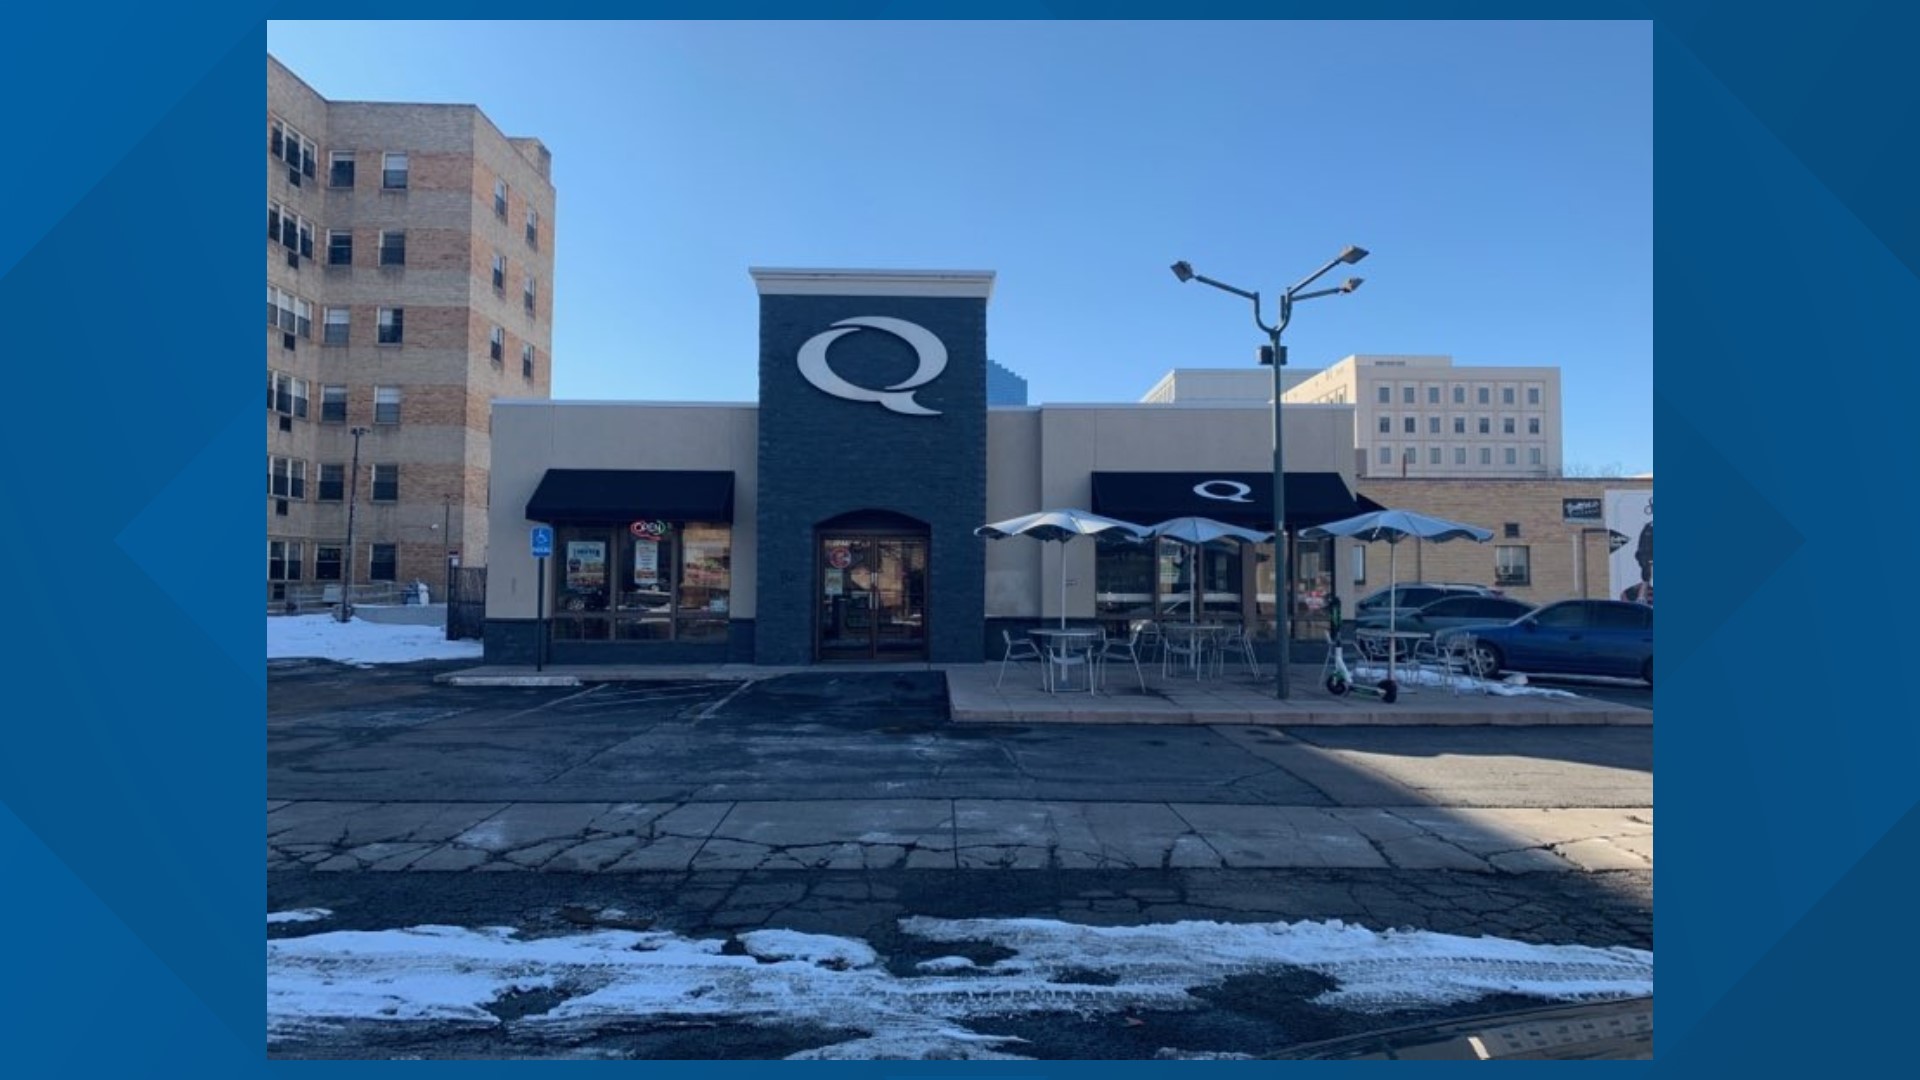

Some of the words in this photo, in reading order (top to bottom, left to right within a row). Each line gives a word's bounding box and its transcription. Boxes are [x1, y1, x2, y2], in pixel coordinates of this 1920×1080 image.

[797, 316, 948, 415] Q
[1193, 480, 1255, 503] Q
[633, 520, 664, 536] OPEN
